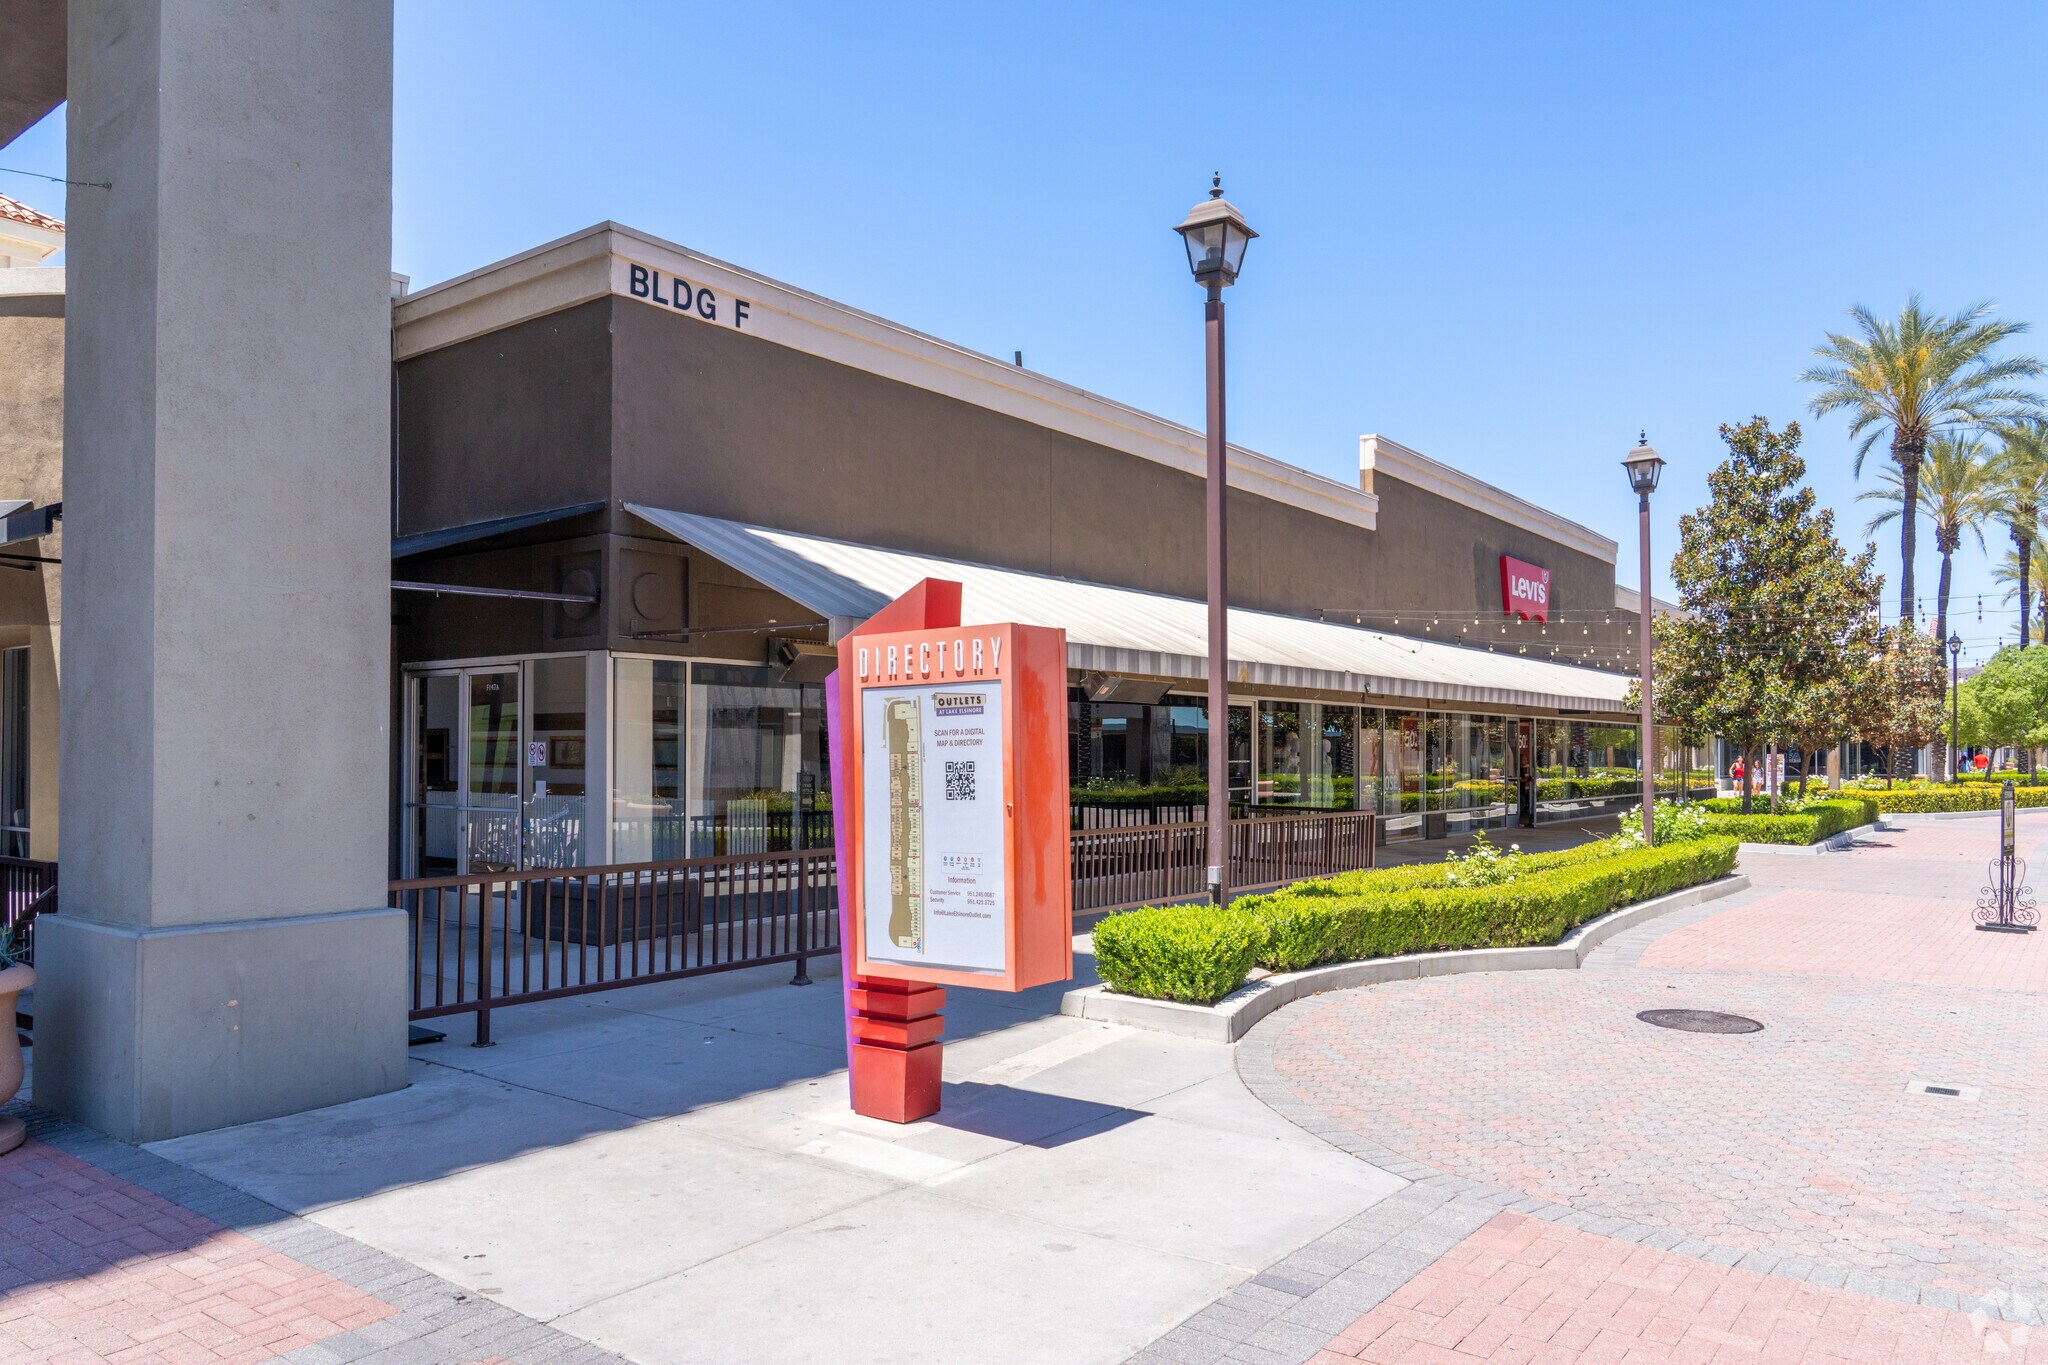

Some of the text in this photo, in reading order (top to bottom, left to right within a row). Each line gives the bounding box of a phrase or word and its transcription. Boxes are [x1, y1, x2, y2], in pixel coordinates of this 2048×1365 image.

[630, 263, 750, 328] BLDG F
[1511, 575, 1546, 604] Levi's
[859, 636, 1001, 678] DIRECTORY
[938, 696, 982, 706] OUTLETS
[934, 729, 949, 737] SCAN
[949, 728, 960, 736] FOR
[965, 727, 985, 735] DIGITAL
[936, 739, 948, 747] MAP
[954, 738, 983, 747] DIRECTORY
[948, 876, 976, 884] Information
[930, 896, 944, 904] Security
